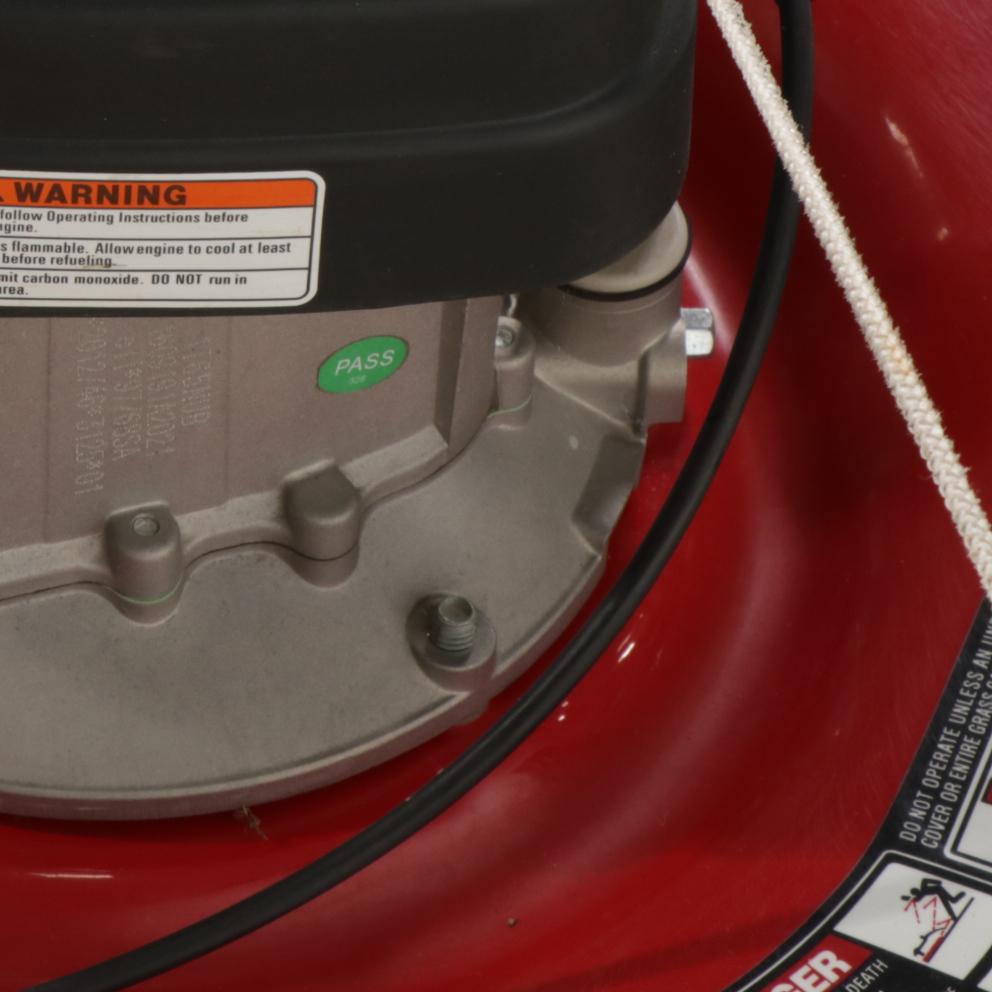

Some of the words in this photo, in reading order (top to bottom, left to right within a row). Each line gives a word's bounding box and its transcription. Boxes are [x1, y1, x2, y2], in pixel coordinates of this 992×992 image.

[14, 181, 187, 206] WARNING
[0, 209, 42, 222] follow
[47, 210, 114, 226] Operating
[119, 212, 200, 223] Instructions
[204, 212, 248, 223] before
[2, 253, 46, 265] before
[12, 241, 88, 254] flammable.
[95, 242, 134, 254] Allow
[136, 242, 184, 258] engine
[188, 244, 201, 255] to
[206, 242, 235, 255] cool
[239, 243, 254, 254] at
[258, 242, 292, 254] least
[22, 273, 68, 284] carbon
[74, 274, 144, 285] monoxide.
[152, 274, 170, 284] DO
[176, 274, 202, 285] NOT
[209, 276, 230, 285] run
[234, 274, 248, 284] in
[334, 348, 395, 376] PASS
[972, 648, 992, 670] AN
[948, 671, 985, 725] UNLESS
[922, 726, 961, 789] OPERATE
[950, 734, 982, 780] ENTIRE
[940, 780, 963, 804] OR
[910, 790, 934, 821] NOT
[899, 820, 923, 843] DO
[920, 805, 954, 850] COVER
[845, 959, 888, 992] DEATH
